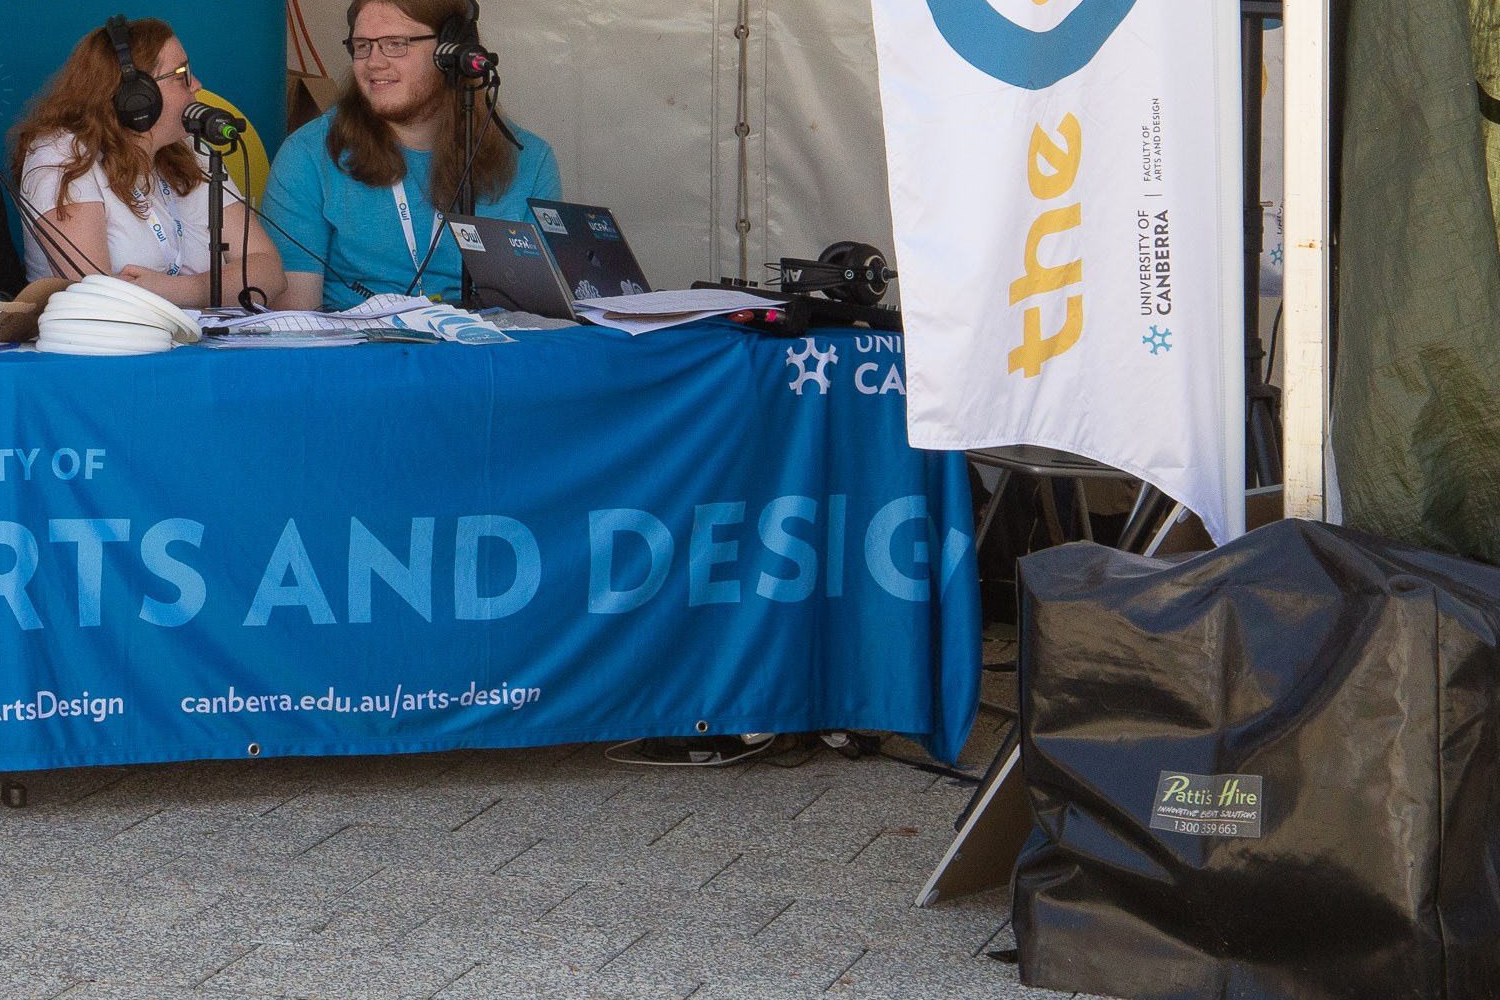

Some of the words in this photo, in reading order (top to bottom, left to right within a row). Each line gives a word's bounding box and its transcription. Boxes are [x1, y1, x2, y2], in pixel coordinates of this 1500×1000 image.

[1142, 125, 1150, 138] OF
[1152, 98, 1160, 133] DESIGN
[1143, 141, 1151, 181] FACULTY
[1153, 135, 1161, 156] AND
[1154, 158, 1162, 181] ARTS
[1138, 210, 1150, 230] OF
[508, 237, 529, 249] UCFM
[1008, 112, 1083, 378] the
[1139, 233, 1153, 316] UNIVERSITY
[1153, 209, 1172, 316] CANBERRA
[51, 447, 107, 481] OF
[242, 515, 542, 627] AND
[181, 681, 542, 718] canberra.edu.au/arts-design
[1162, 775, 1213, 806] Patti's
[1217, 778, 1257, 807] Hire
[1174, 820, 1199, 833] 1300
[1201, 823, 1217, 834] 359
[1218, 824, 1238, 835] 663
